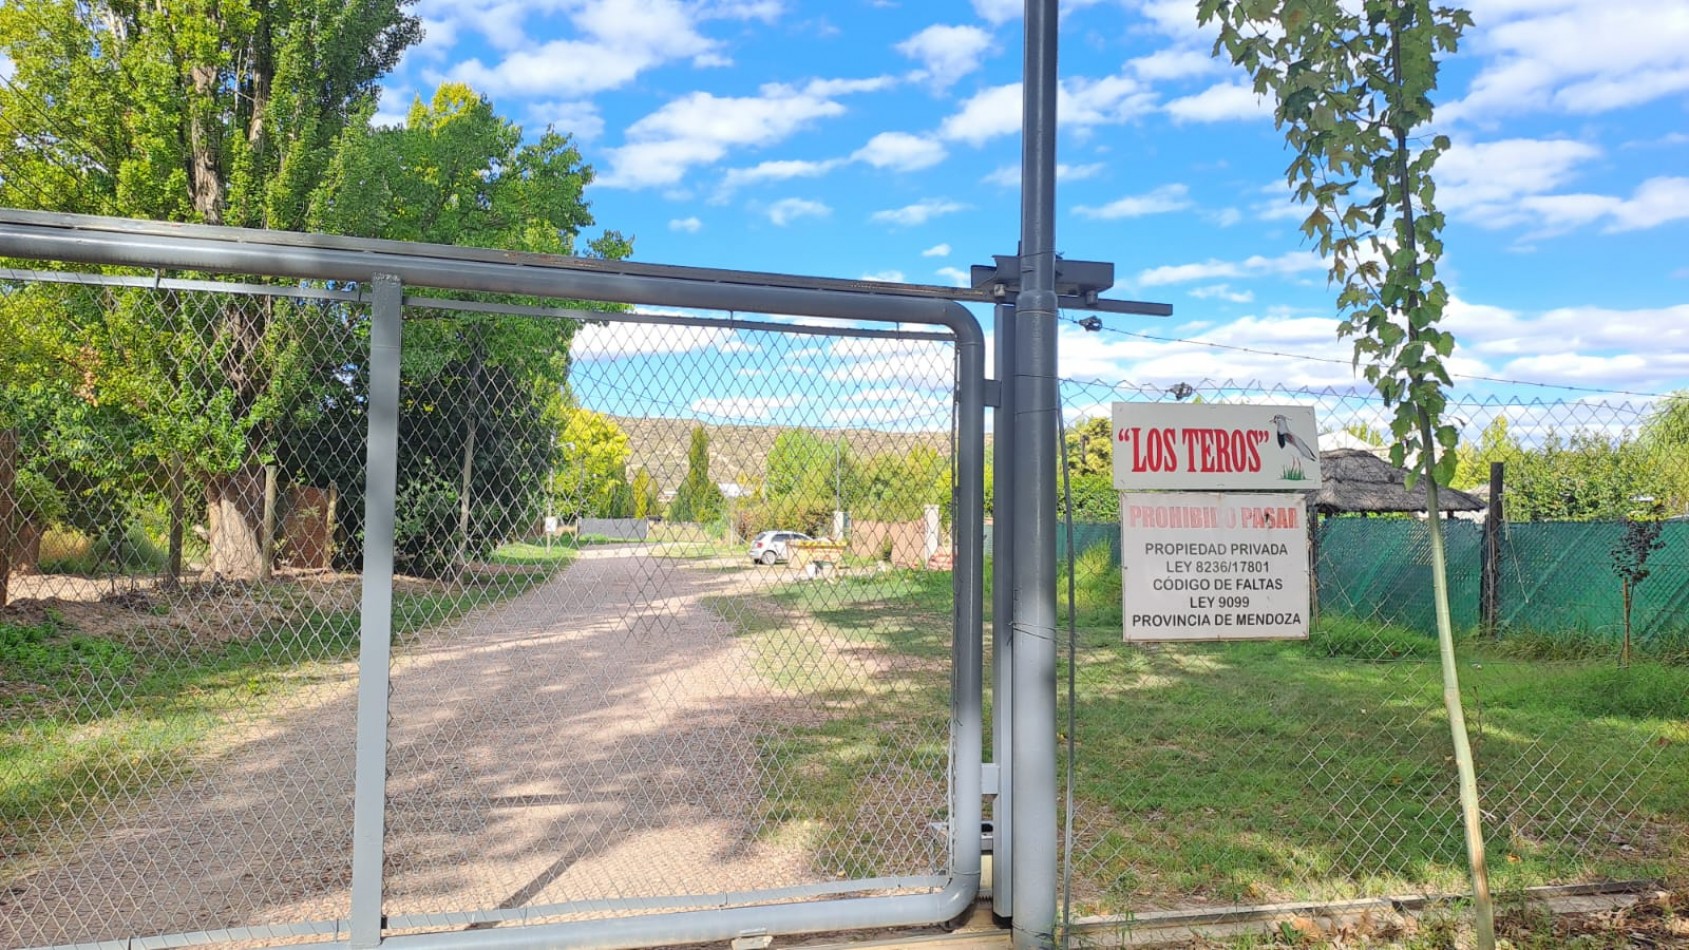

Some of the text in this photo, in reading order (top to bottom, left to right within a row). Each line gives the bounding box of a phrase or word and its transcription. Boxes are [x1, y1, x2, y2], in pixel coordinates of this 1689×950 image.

[1145, 543, 1288, 555] PROPIEDAD PRIVADA
[1166, 561, 1269, 573] LEY 8236/17801
[1153, 576, 1283, 591] CÓDIGO DE FALTAS
[1190, 596, 1250, 609] LEY 9099
[1132, 613, 1301, 627] PROVINCIA DE MENDOZA
